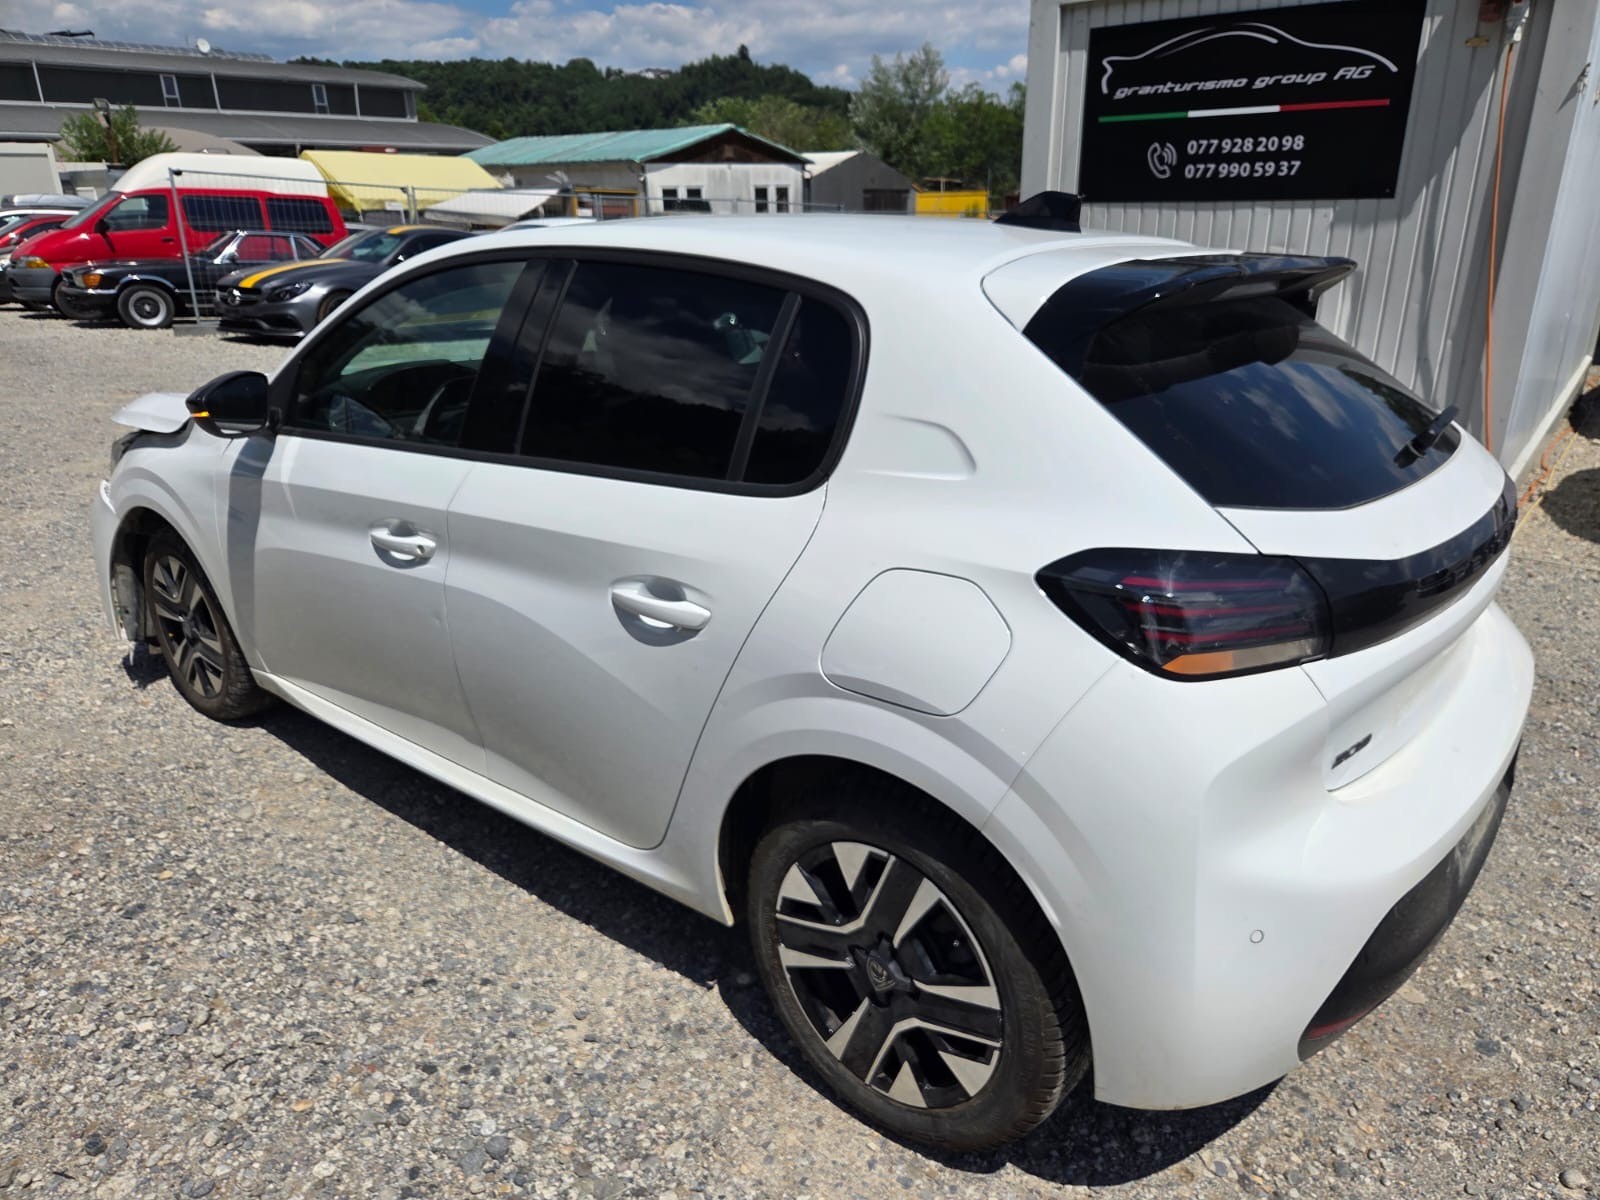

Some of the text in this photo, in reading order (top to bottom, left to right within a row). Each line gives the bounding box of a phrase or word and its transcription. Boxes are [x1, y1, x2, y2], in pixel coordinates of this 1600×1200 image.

[1113, 65, 1376, 100] granturismo group AG
[1187, 134, 1305, 155] 077 928 20 98
[1184, 160, 1302, 179] 077 990 59 37
